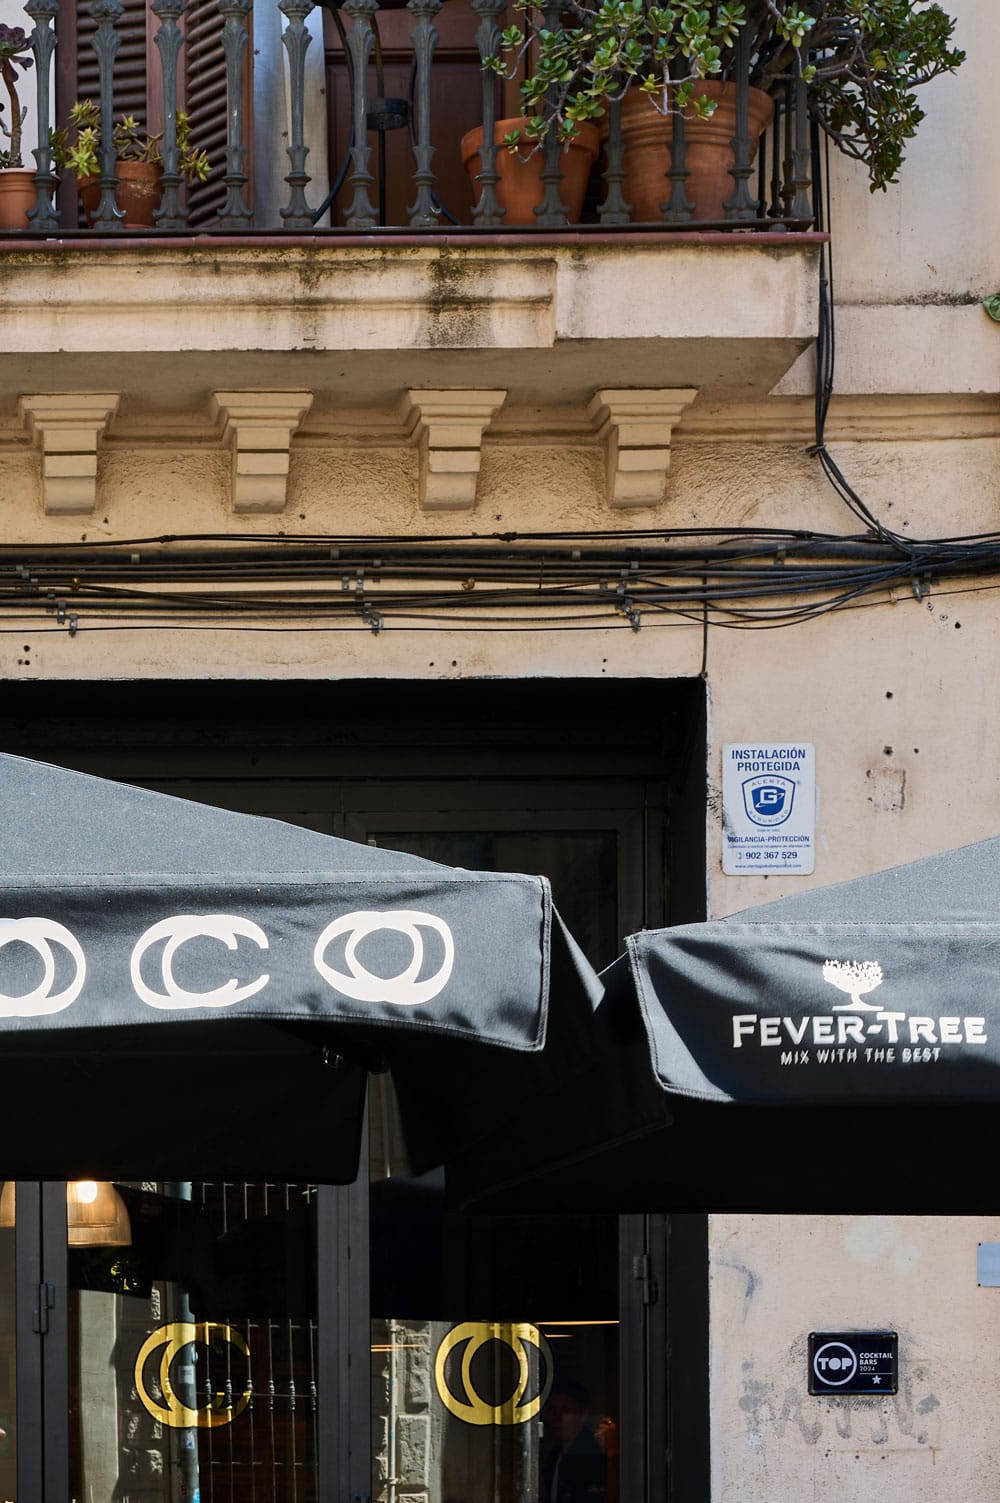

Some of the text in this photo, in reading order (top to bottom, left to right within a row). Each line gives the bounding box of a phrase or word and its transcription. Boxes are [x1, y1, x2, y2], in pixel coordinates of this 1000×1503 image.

[731, 747, 806, 760] INSTALACIÓN
[737, 761, 801, 771] PROTEGIDA
[745, 851, 798, 860] 902 367 529
[732, 1011, 988, 1048] FEVER-TREE
[780, 1048, 941, 1065] MIX WITH THE BEST
[817, 1357, 853, 1370] TOP
